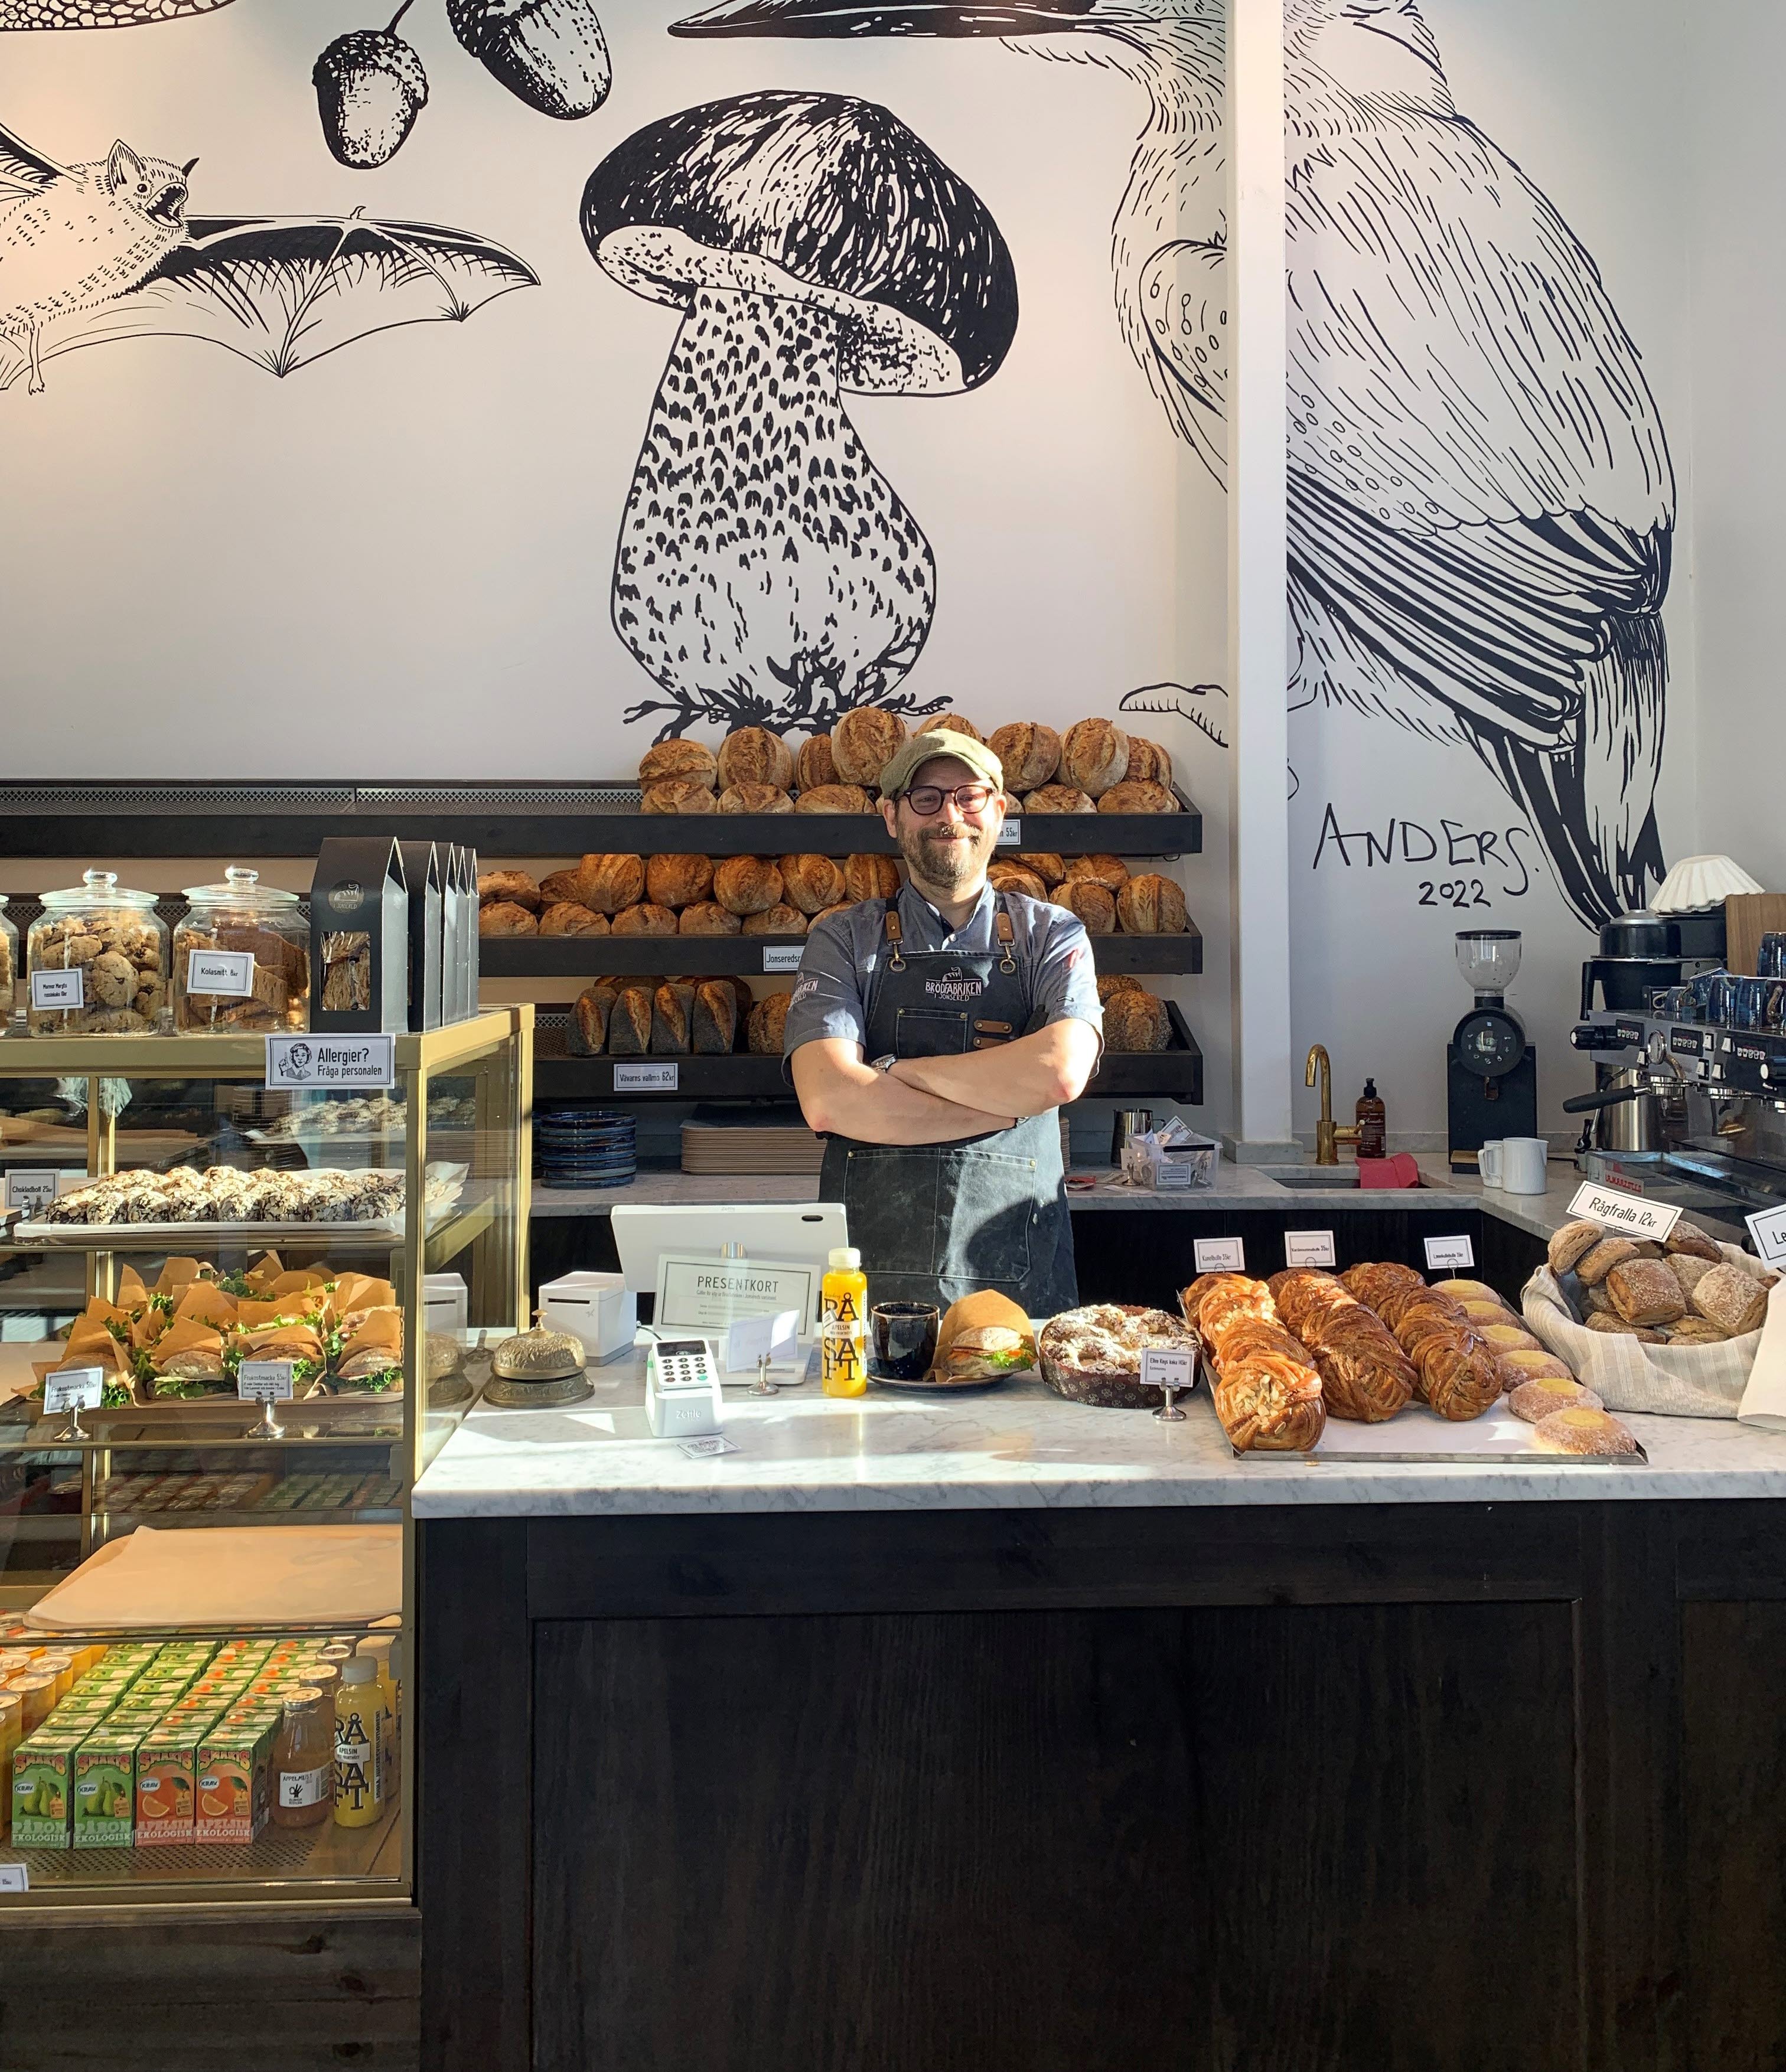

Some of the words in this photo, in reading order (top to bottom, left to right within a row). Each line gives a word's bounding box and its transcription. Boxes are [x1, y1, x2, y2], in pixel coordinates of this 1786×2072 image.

[1006, 827, 1017, 837] 55kr
[1419, 879, 1491, 908] 2022
[201, 967, 228, 976] Kolasnitt
[925, 981, 981, 994] BRÖDFABRIKEN
[938, 993, 970, 1001] JONSERED
[318, 1048, 369, 1066] Allergier?
[318, 1065, 338, 1078] Fråga
[341, 1065, 382, 1078] personalen
[662, 1071, 675, 1081] 62kr
[1589, 1197, 1637, 1223] Rågfralla
[1638, 1212, 1657, 1228] 12kr
[698, 1276, 778, 1293] PRESENTKORT
[51, 1383, 84, 1392] Frukostmacka
[676, 1409, 702, 1419] Zettle
[14, 1754, 66, 1776] SMAKIS
[77, 1754, 131, 1777] SMAKIS
[138, 1750, 193, 1773] SMAKIS
[198, 1750, 251, 1771] SMAKIS
[12, 1833, 66, 1842] EKOLOGISK
[75, 1832, 131, 1842] EKOLOGISK
[138, 1830, 193, 1839] EKOLOGISK
[197, 1829, 250, 1837] EKOLOGISK
